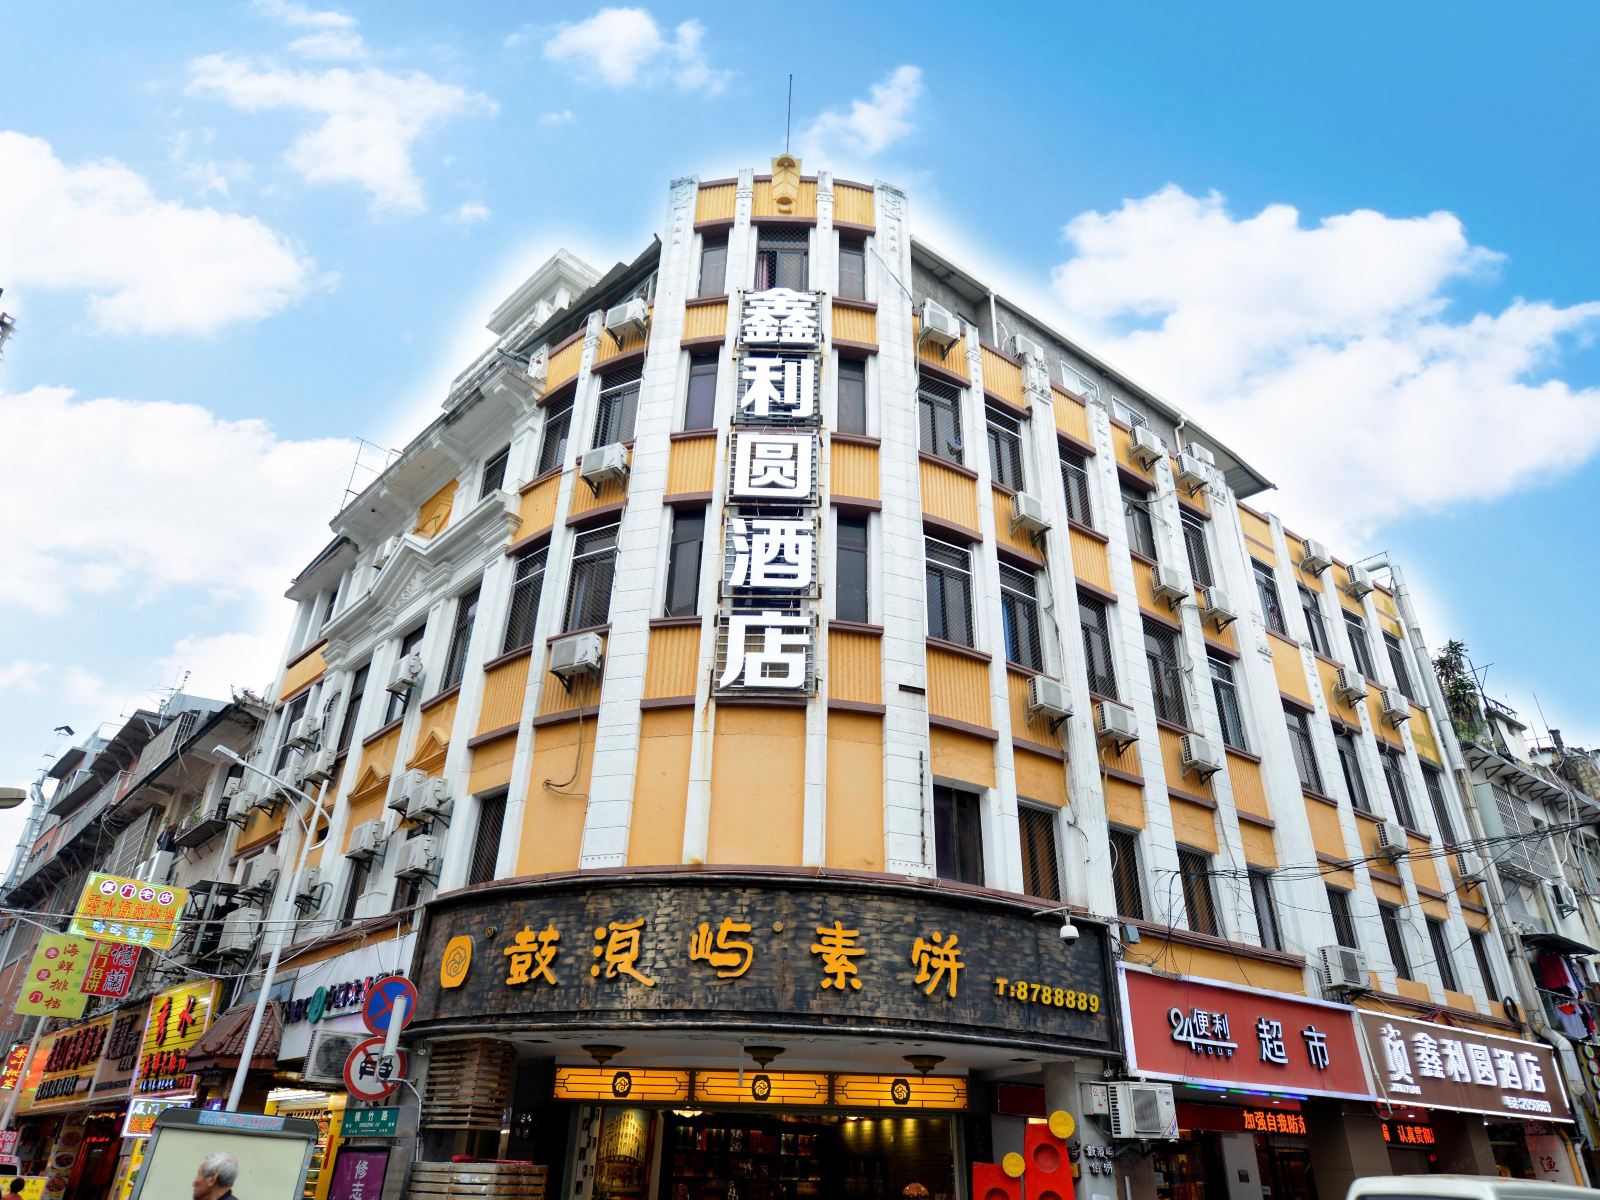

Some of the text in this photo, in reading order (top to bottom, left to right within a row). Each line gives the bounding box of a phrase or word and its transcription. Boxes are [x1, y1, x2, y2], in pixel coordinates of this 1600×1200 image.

[719, 288, 820, 690] 鑫利圆酒店
[995, 977, 1100, 1013] T:8788889
[1197, 1046, 1233, 1057] HOUR
[1411, 1032, 1546, 1093] 鑫利圆酒店
